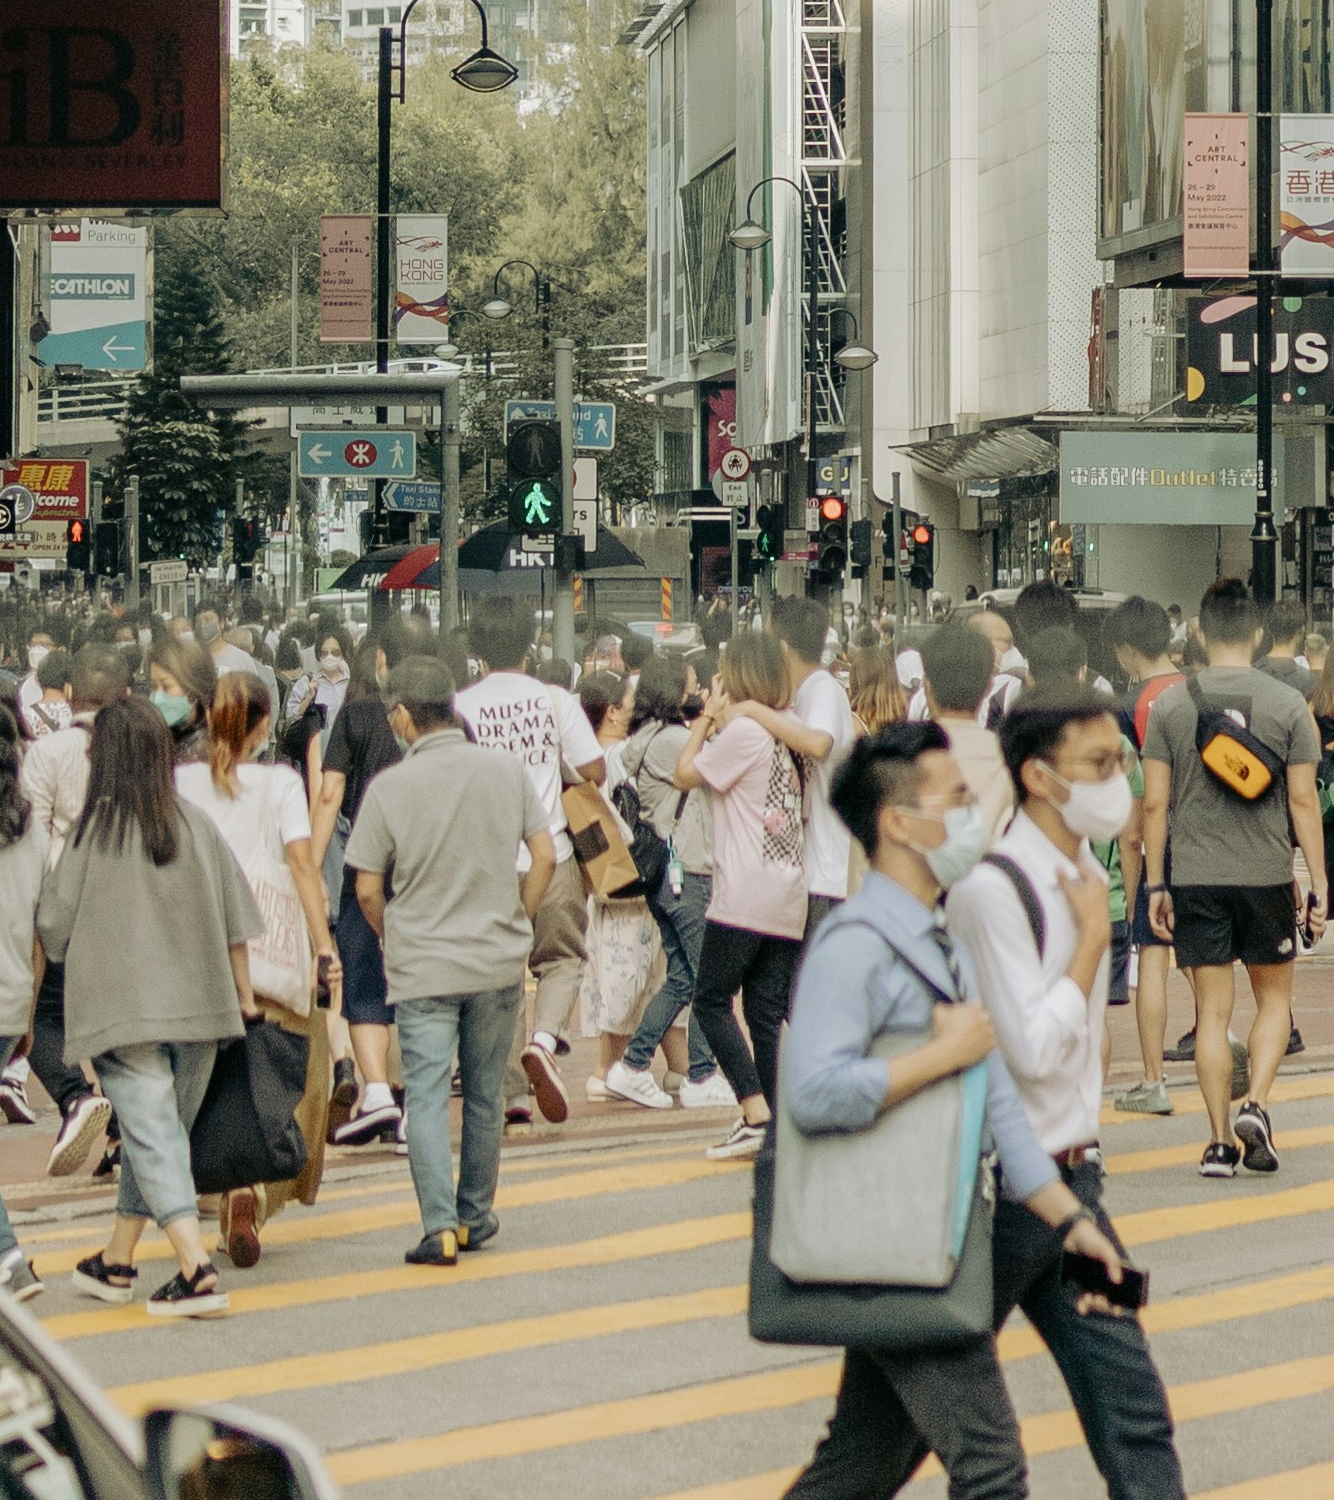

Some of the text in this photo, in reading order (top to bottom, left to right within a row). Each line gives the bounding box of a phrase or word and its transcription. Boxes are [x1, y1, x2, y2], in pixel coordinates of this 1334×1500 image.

[88, 230, 136, 245] Parking
[400, 259, 444, 270] HONG
[400, 270, 444, 281] KONG
[18, 464, 75, 491] 惠康
[400, 484, 417, 494] Taxi
[35, 492, 79, 507] lcome
[403, 494, 439, 507] 的士站
[477, 713, 556, 738] DRAMA
[542, 731, 556, 747] &
